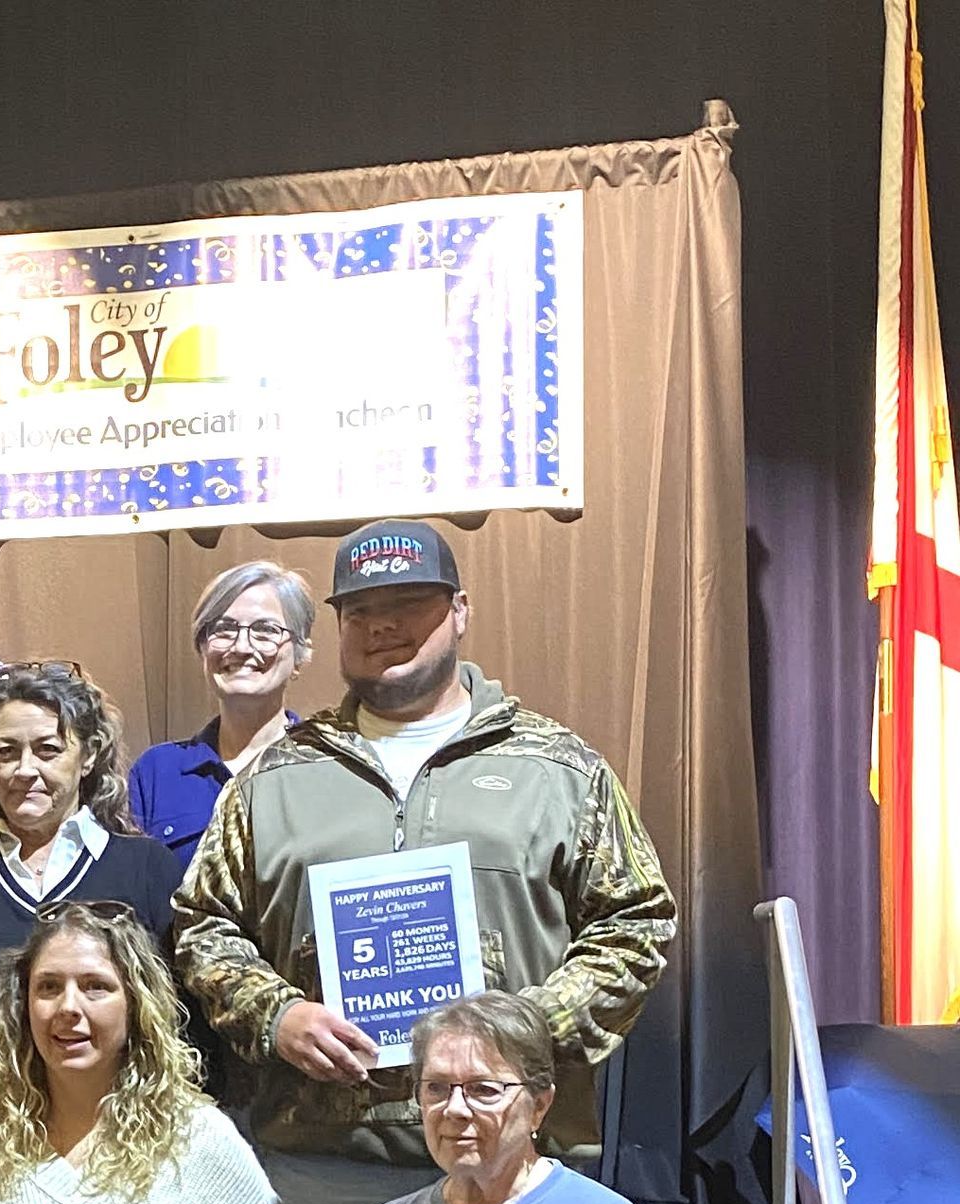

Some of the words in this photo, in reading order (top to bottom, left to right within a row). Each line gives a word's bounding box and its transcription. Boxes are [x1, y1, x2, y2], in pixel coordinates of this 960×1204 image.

[90, 297, 138, 327] City
[144, 291, 171, 325] of
[99, 406, 281, 450] Appreciatn
[350, 537, 381, 572] RED
[381, 535, 423, 565] DIRT
[334, 892, 368, 905] HAPPY
[372, 881, 445, 900] ANNIVERSARY
[354, 903, 383, 918] Zevin
[385, 897, 427, 913] Chavers
[391, 929, 403, 938] 60
[405, 923, 448, 936] MONTHS
[392, 937, 410, 947] 261
[412, 932, 445, 944] WEEKS
[351, 937, 376, 964] 5
[394, 945, 425, 957] 1,826
[425, 941, 456, 953] DAYS
[422, 952, 452, 962] HOURS
[342, 965, 388, 981] YEARS
[344, 989, 414, 1013] THANK
[418, 983, 461, 1004] YOU
